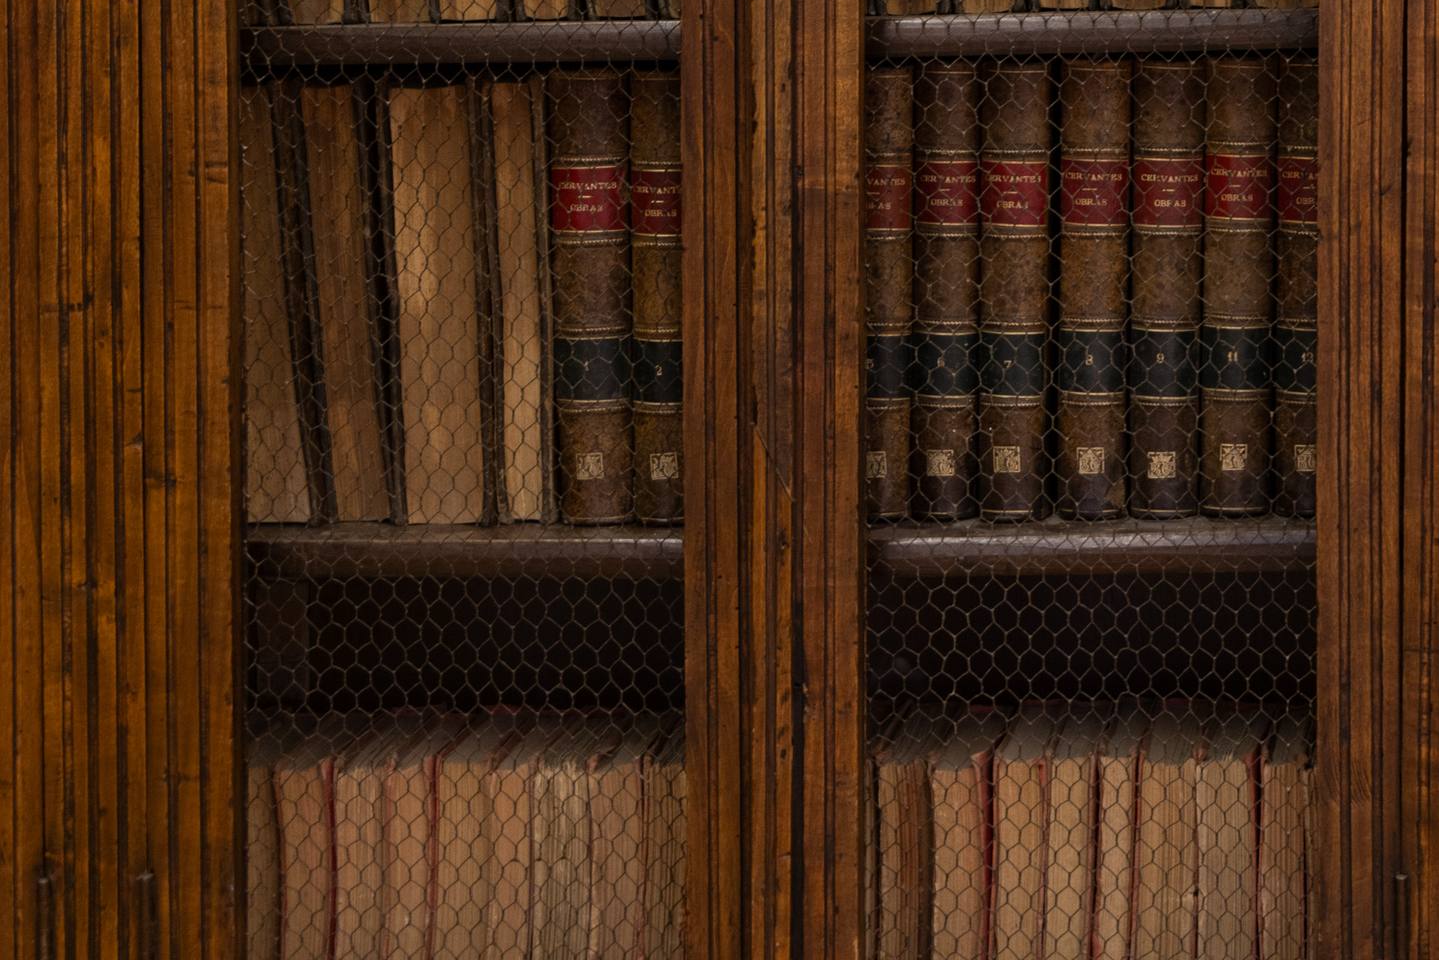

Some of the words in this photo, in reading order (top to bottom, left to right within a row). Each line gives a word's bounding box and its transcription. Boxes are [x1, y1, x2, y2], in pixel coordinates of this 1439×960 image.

[1085, 354, 1094, 366] 8
[1155, 352, 1166, 364] 9
[1226, 350, 1239, 363] 11
[655, 364, 663, 376] 2
[1003, 359, 1013, 369] 7
